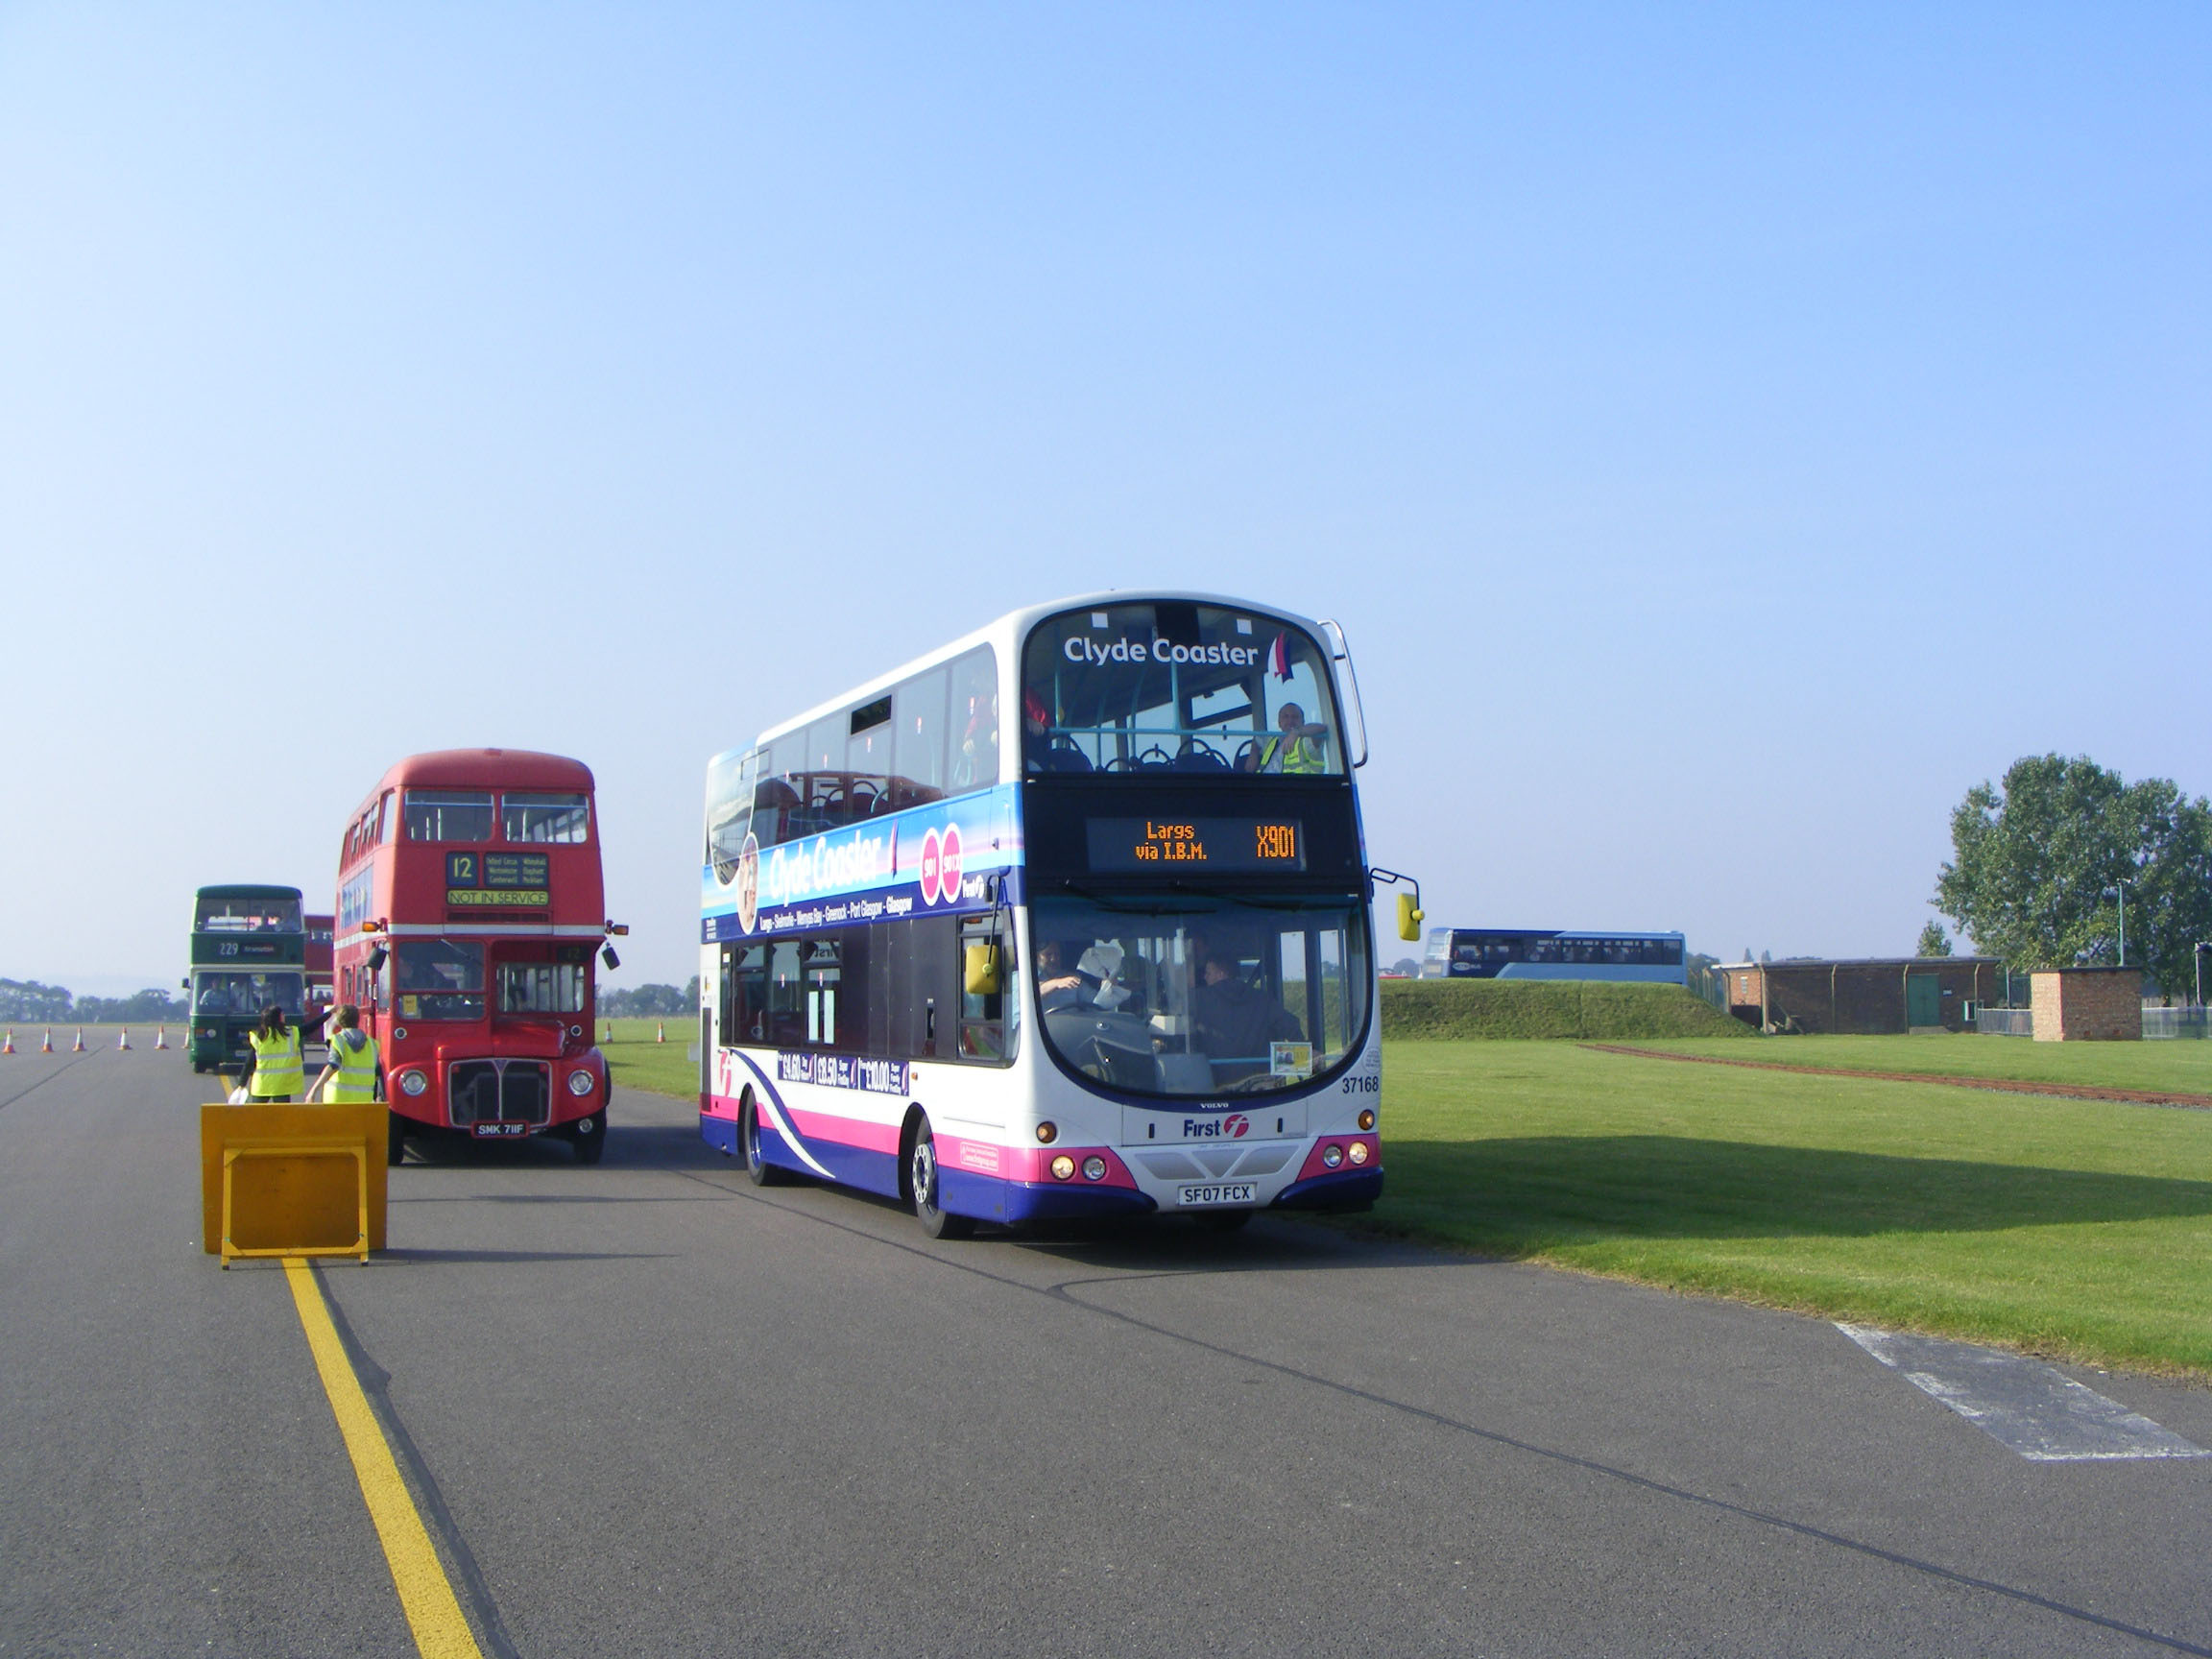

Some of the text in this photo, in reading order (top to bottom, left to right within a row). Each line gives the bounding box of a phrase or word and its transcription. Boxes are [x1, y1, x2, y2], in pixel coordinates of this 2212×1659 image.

[1064, 637, 1259, 666] Clyde Coaster
[1146, 821, 1195, 839] Largs
[1135, 842, 1207, 860] via I.B.M.
[1256, 826, 1295, 857] X901
[454, 857, 471, 878] 12
[769, 829, 881, 907] Clyde Coaster
[925, 857, 937, 878] 901
[449, 893, 545, 903] NOT IN SERVICE
[825, 903, 847, 922] Greenock
[850, 902, 860, 918] Port
[861, 900, 882, 920] Glasgow
[886, 896, 912, 916] Glasgow
[220, 943, 238, 955] 229
[817, 1056, 837, 1086] £8.50
[866, 1061, 890, 1093] £10.00
[1342, 1076, 1379, 1094] 37168
[478, 1124, 523, 1135] SMK 711F
[1184, 1119, 1220, 1137] First
[1185, 1186, 1250, 1202] SF07 FCX
